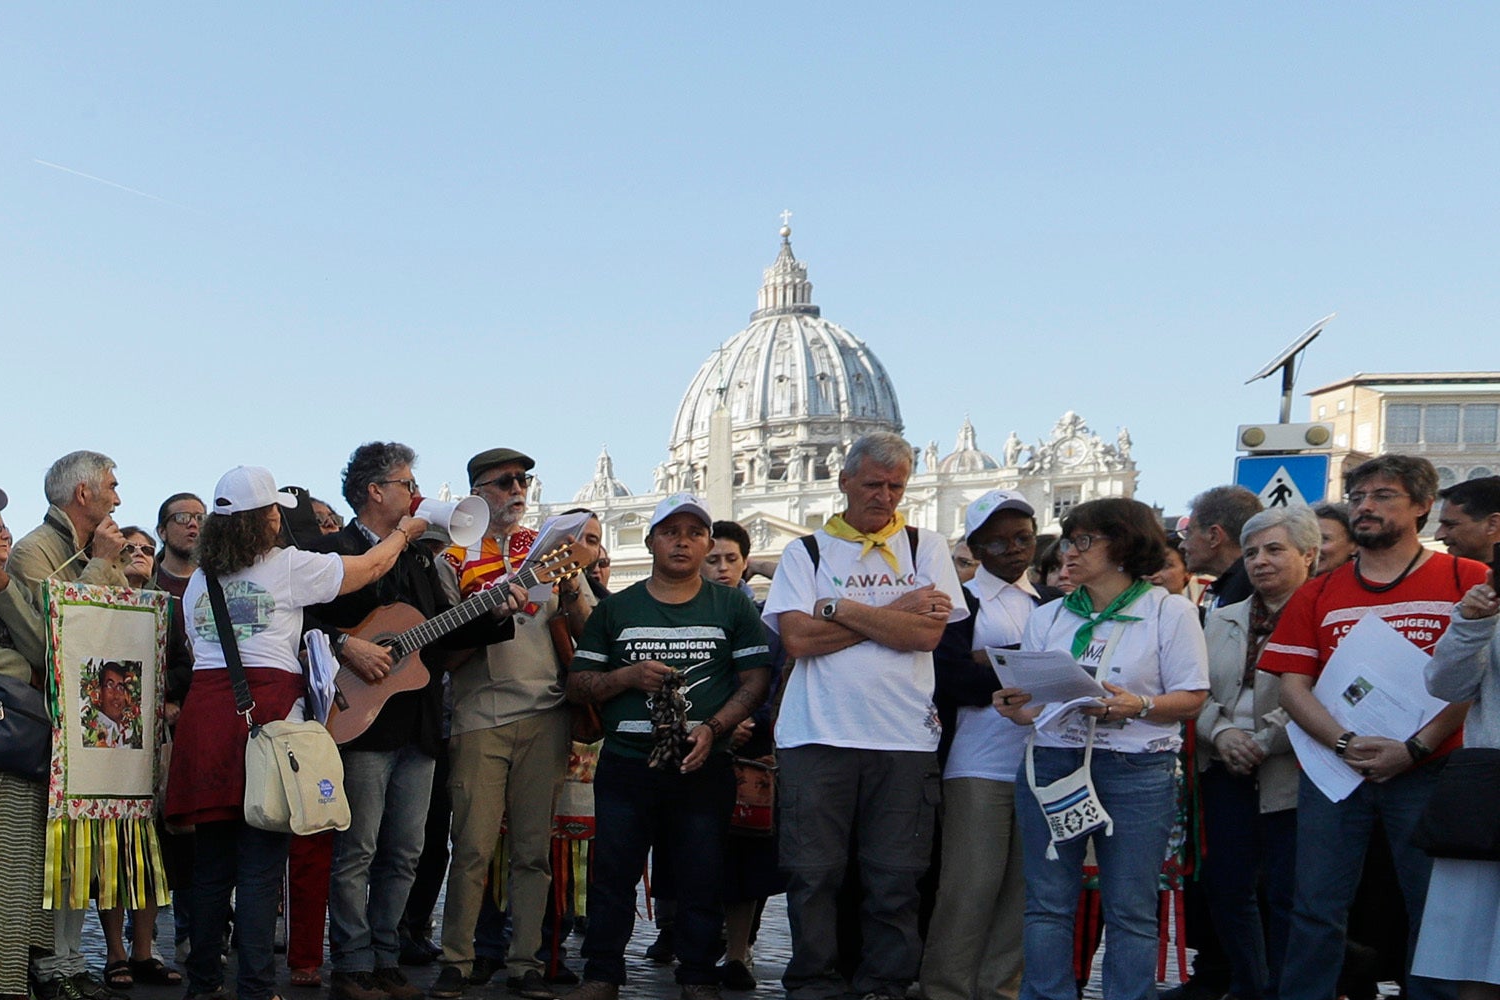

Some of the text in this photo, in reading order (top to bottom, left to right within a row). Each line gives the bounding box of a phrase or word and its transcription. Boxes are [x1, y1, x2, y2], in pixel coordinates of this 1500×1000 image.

[1407, 630, 1433, 641] NÓS
[625, 640, 717, 650] A CAUSA INDÍGENA
[630, 650, 711, 660] É DE TODOS NÓS
